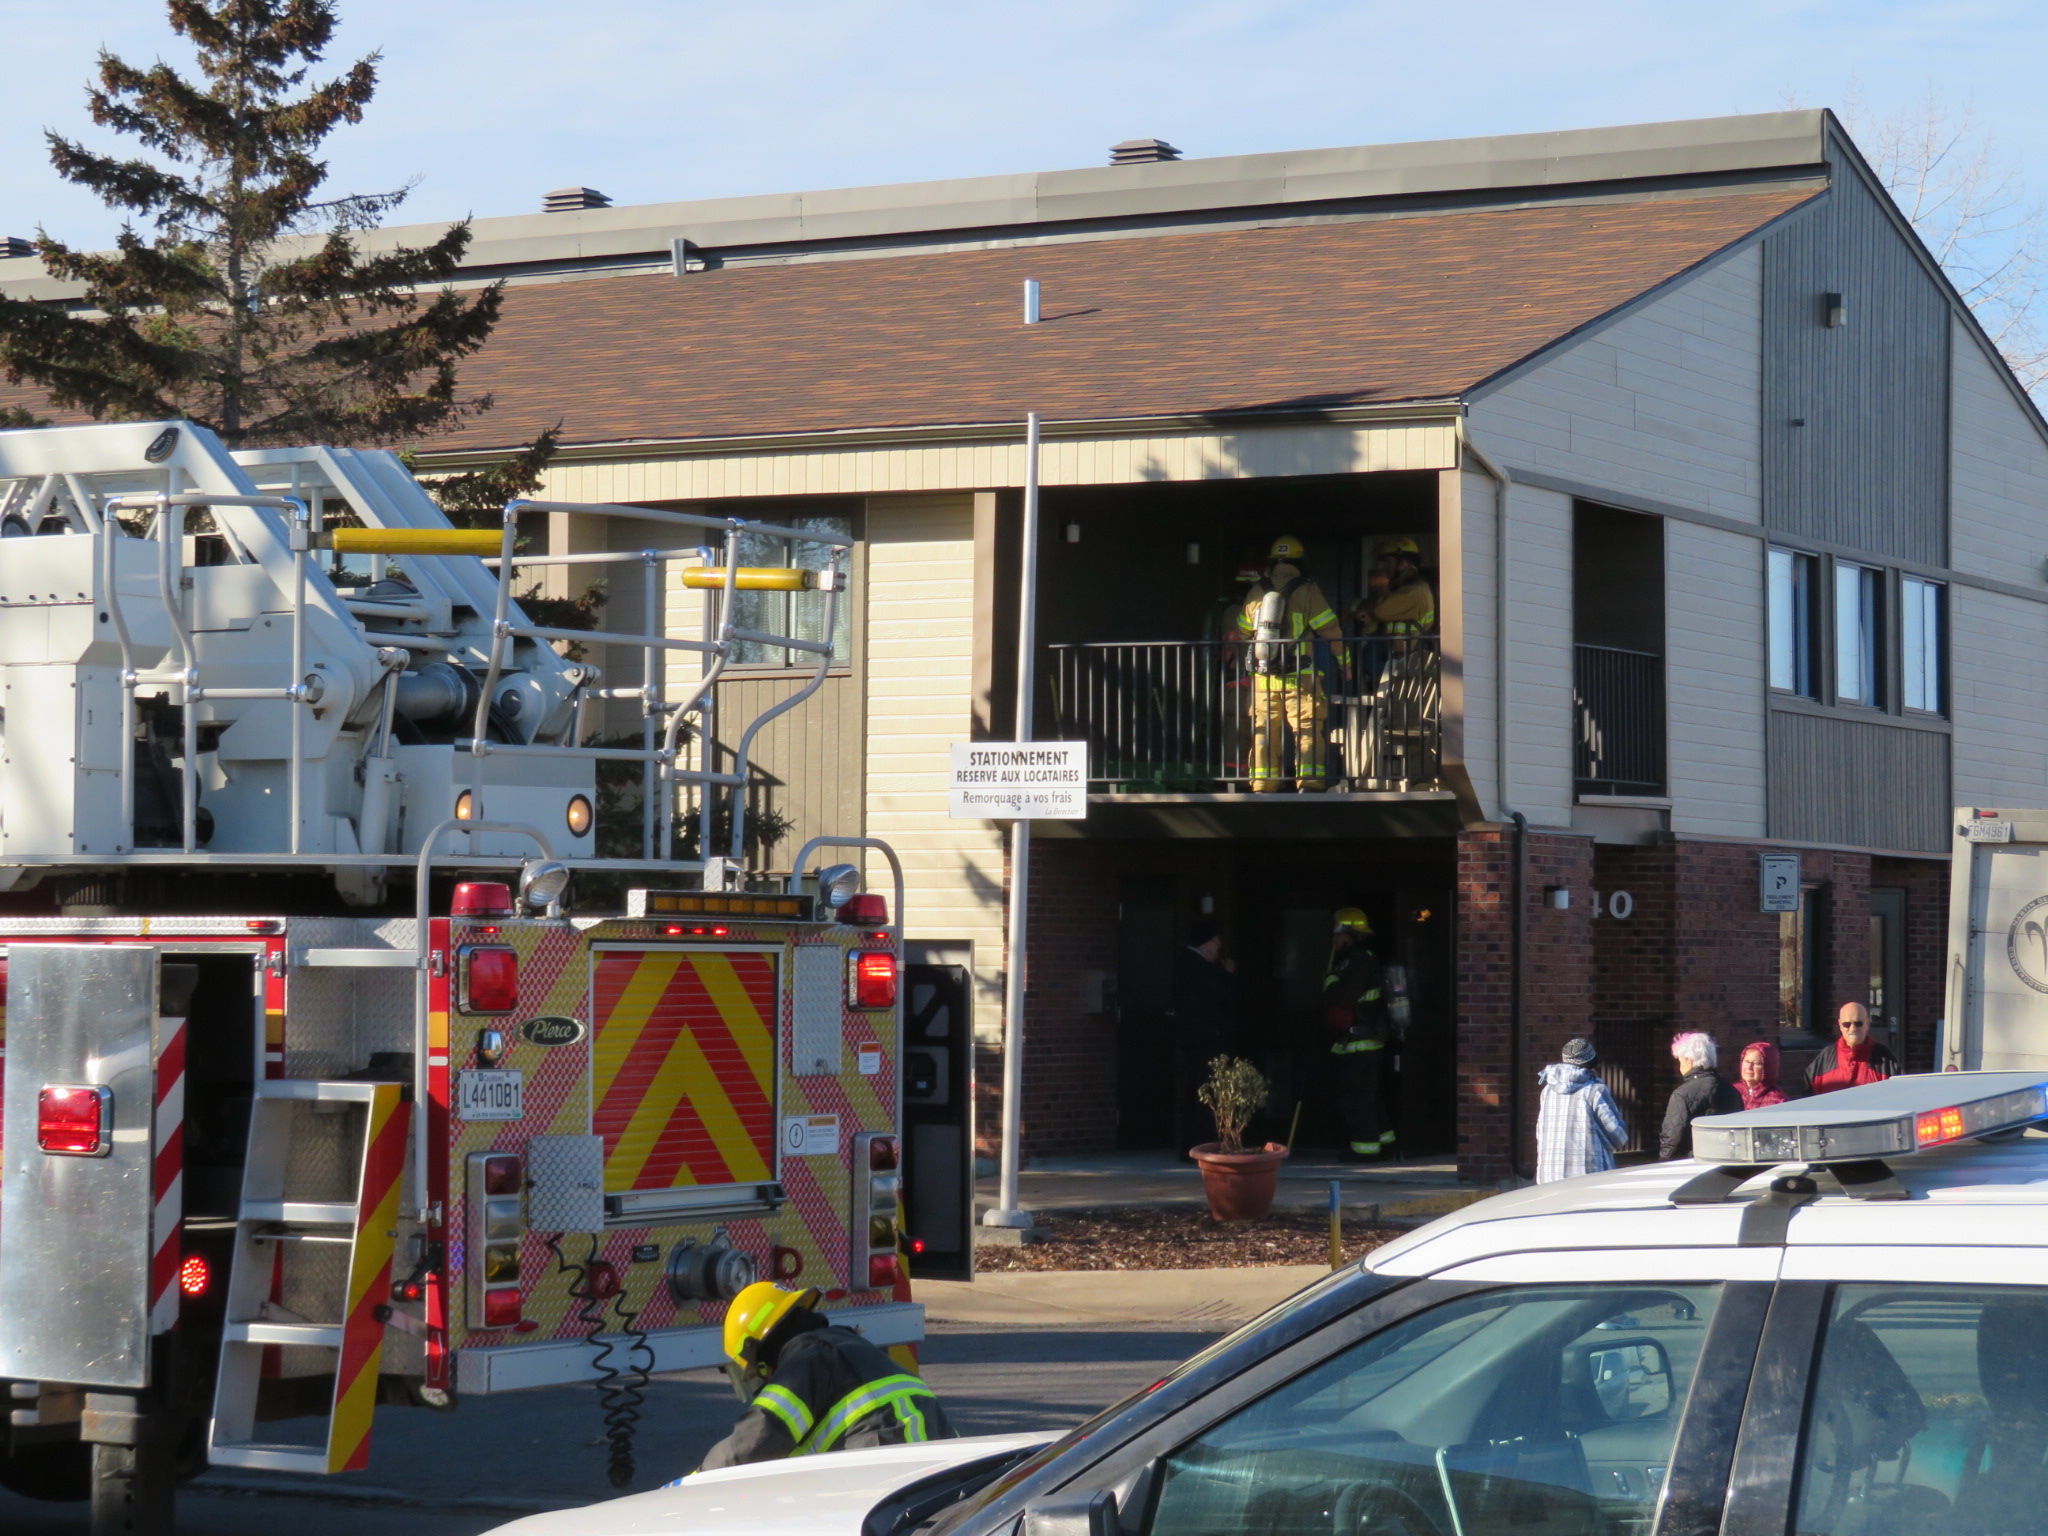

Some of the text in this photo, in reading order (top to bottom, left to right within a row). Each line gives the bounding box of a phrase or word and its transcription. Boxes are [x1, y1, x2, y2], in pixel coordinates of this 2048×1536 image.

[1278, 545, 1288, 553] 23
[970, 751, 1068, 766] STATIONNEMENT
[957, 767, 1079, 782] RÉSERVÉ AUX LOCATAIRES
[963, 791, 1072, 807] Remorquage à vos frais
[2008, 947, 2048, 993] CONSTRUCTIO
[530, 1019, 572, 1041] Pierce
[463, 1083, 519, 1108] L441081
